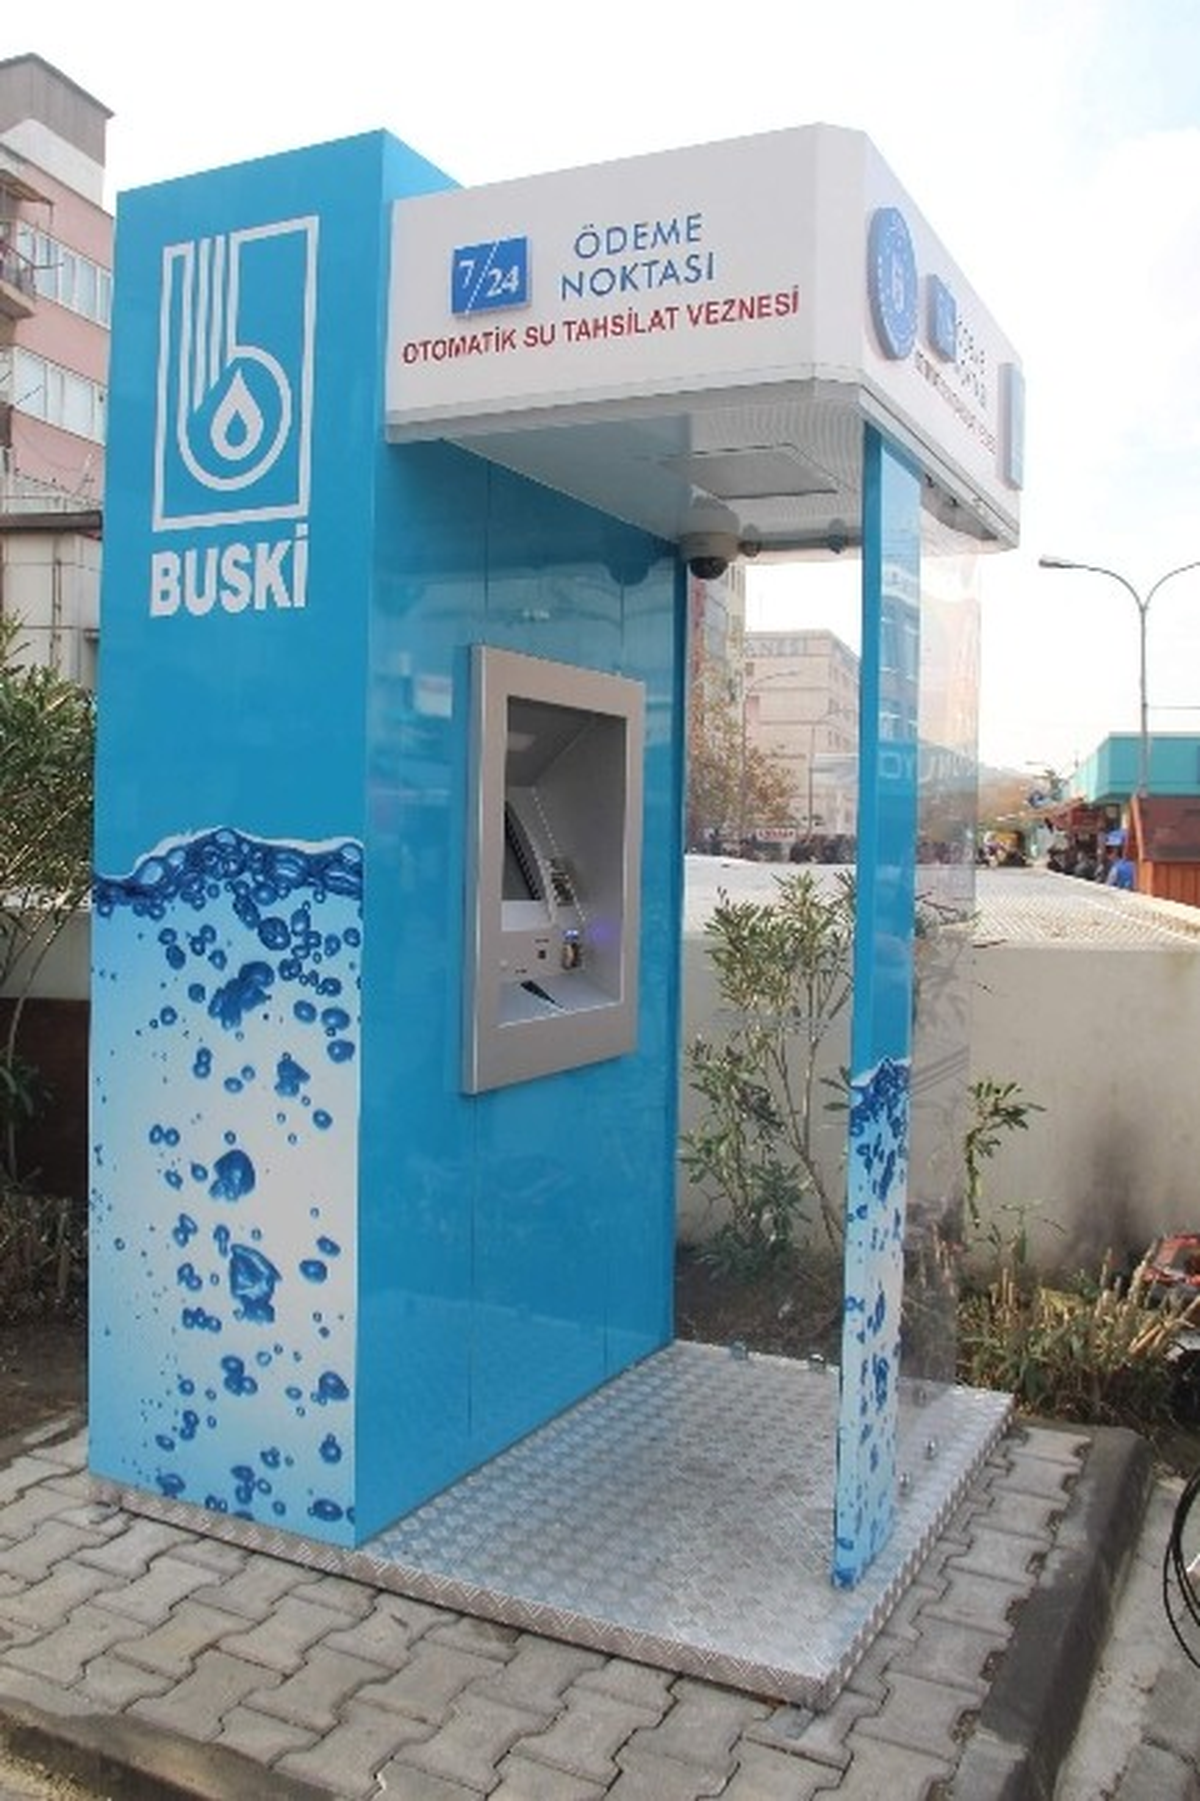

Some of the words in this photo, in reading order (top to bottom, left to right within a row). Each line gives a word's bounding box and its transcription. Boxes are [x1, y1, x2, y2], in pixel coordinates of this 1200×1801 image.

[574, 213, 702, 259] ÖDEME
[457, 243, 520, 313] 7/24
[561, 252, 715, 300] NOKTASI
[402, 327, 517, 364] OTOMATİK
[524, 323, 556, 346] SU
[564, 307, 680, 342] TAHSİLAT
[688, 286, 800, 326] VEZNESİ
[150, 523, 308, 617] BUSKİ
